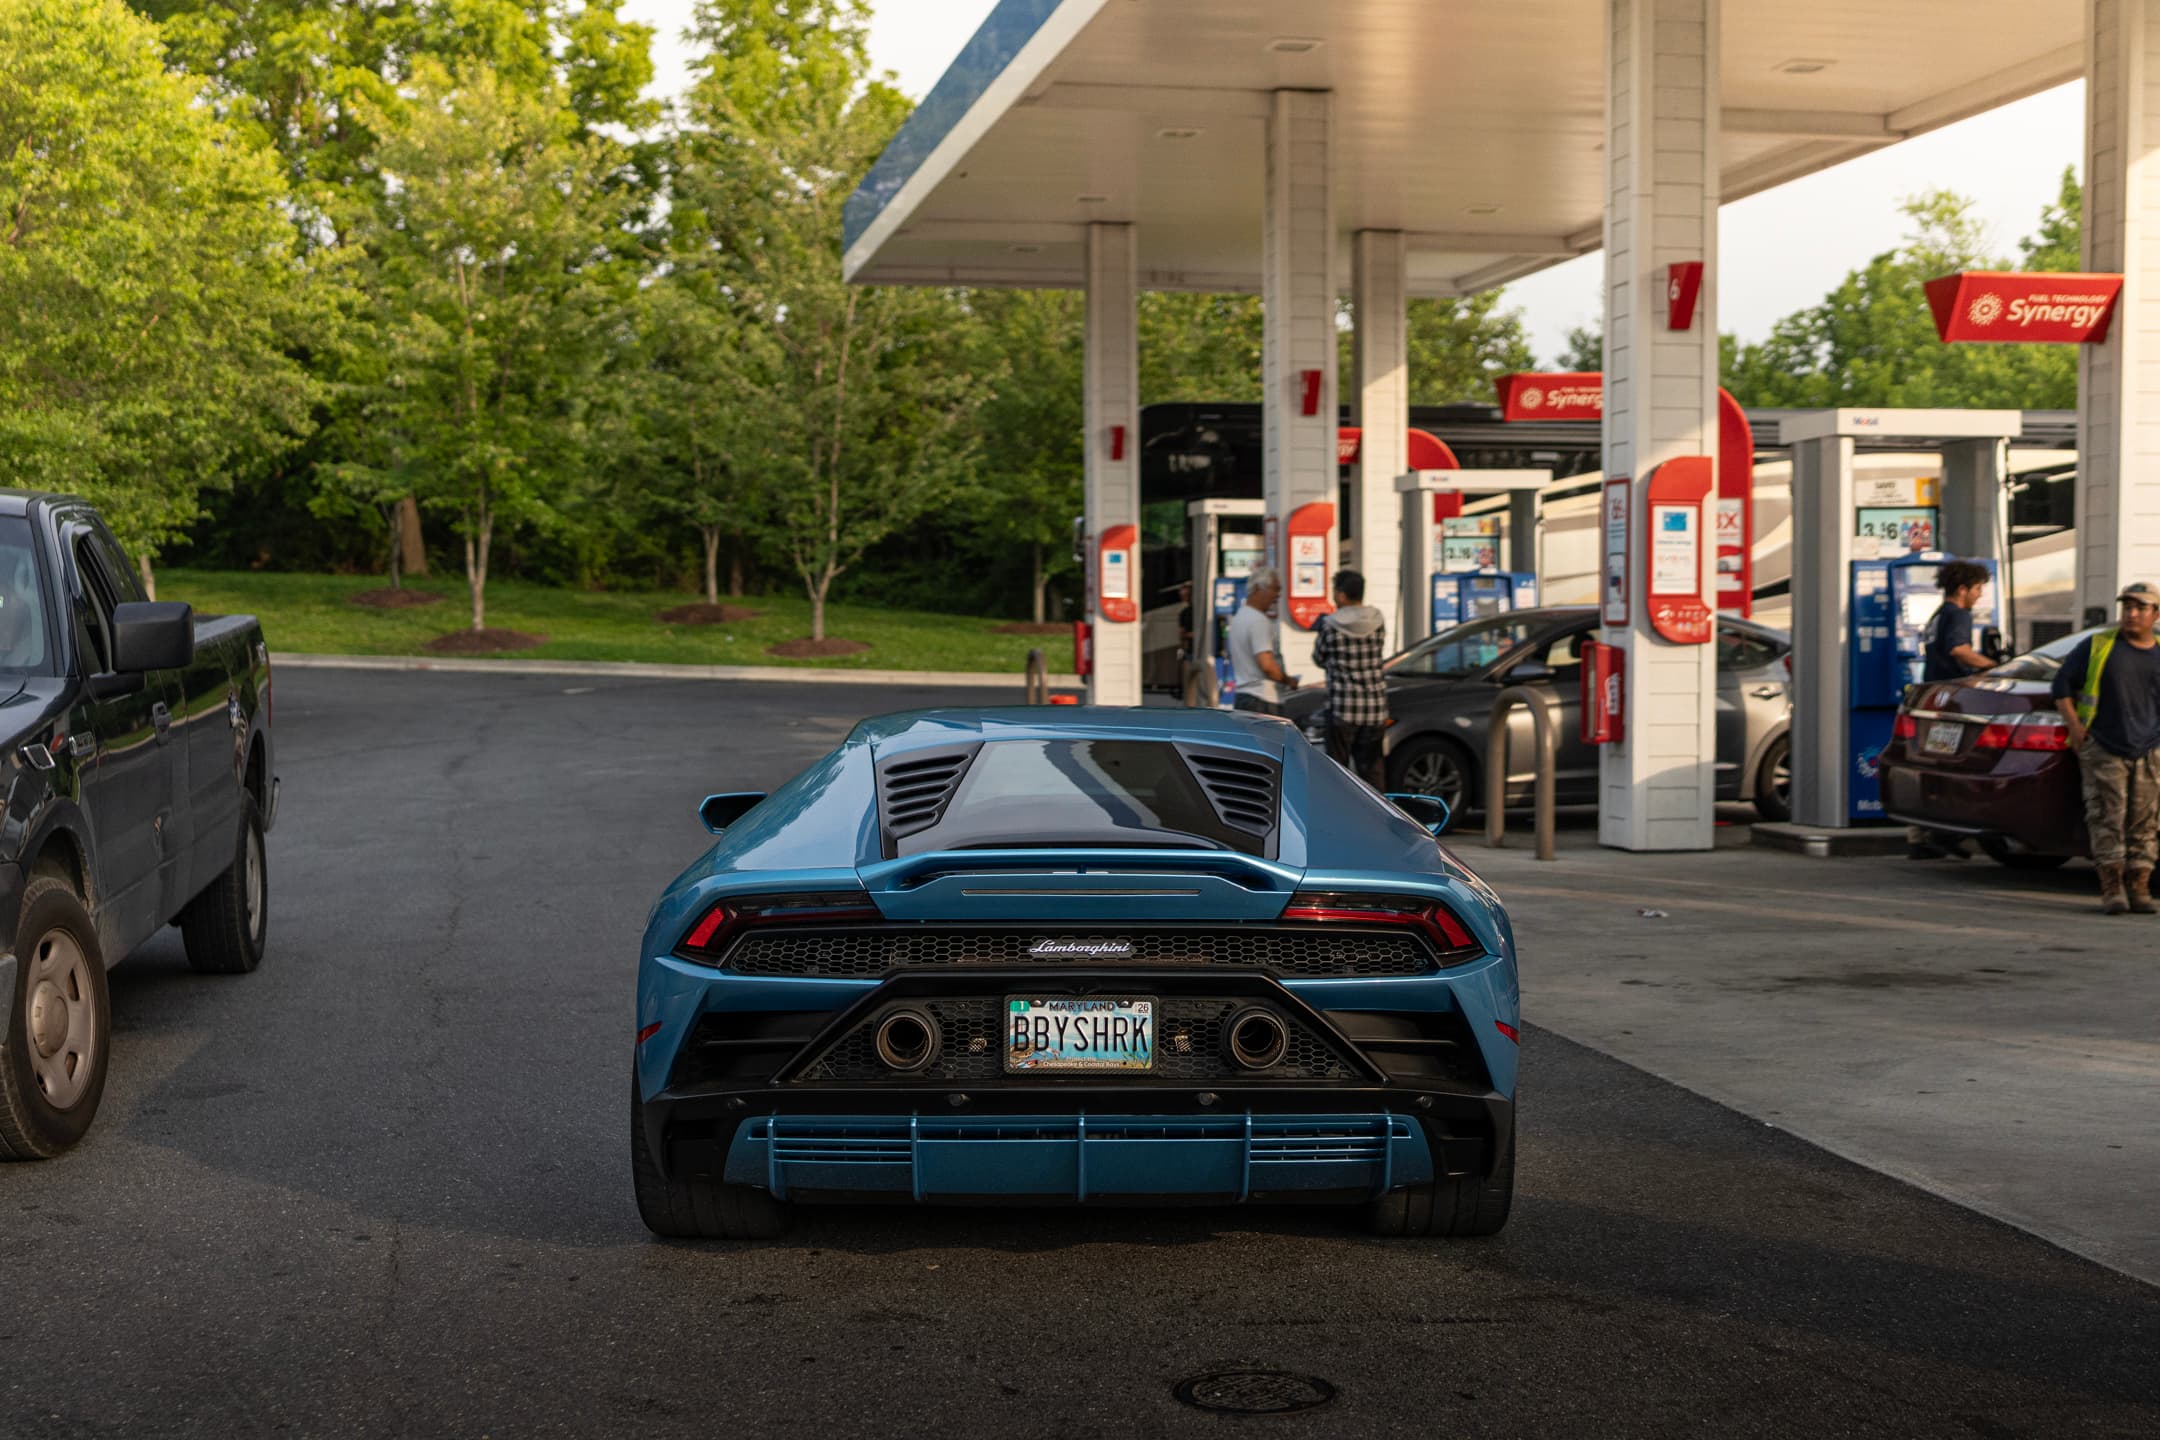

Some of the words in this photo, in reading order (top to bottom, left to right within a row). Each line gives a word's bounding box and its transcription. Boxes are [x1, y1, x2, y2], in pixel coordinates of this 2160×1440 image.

[2006, 298, 2105, 328] Synergy
[1545, 389, 1603, 410] Synerg
[1029, 939, 1131, 955] Lamborghini
[1049, 1001, 1116, 1012] MARYLAND
[1137, 1003, 1149, 1012] 26
[1014, 1015, 1148, 1052] BBYSHRK
